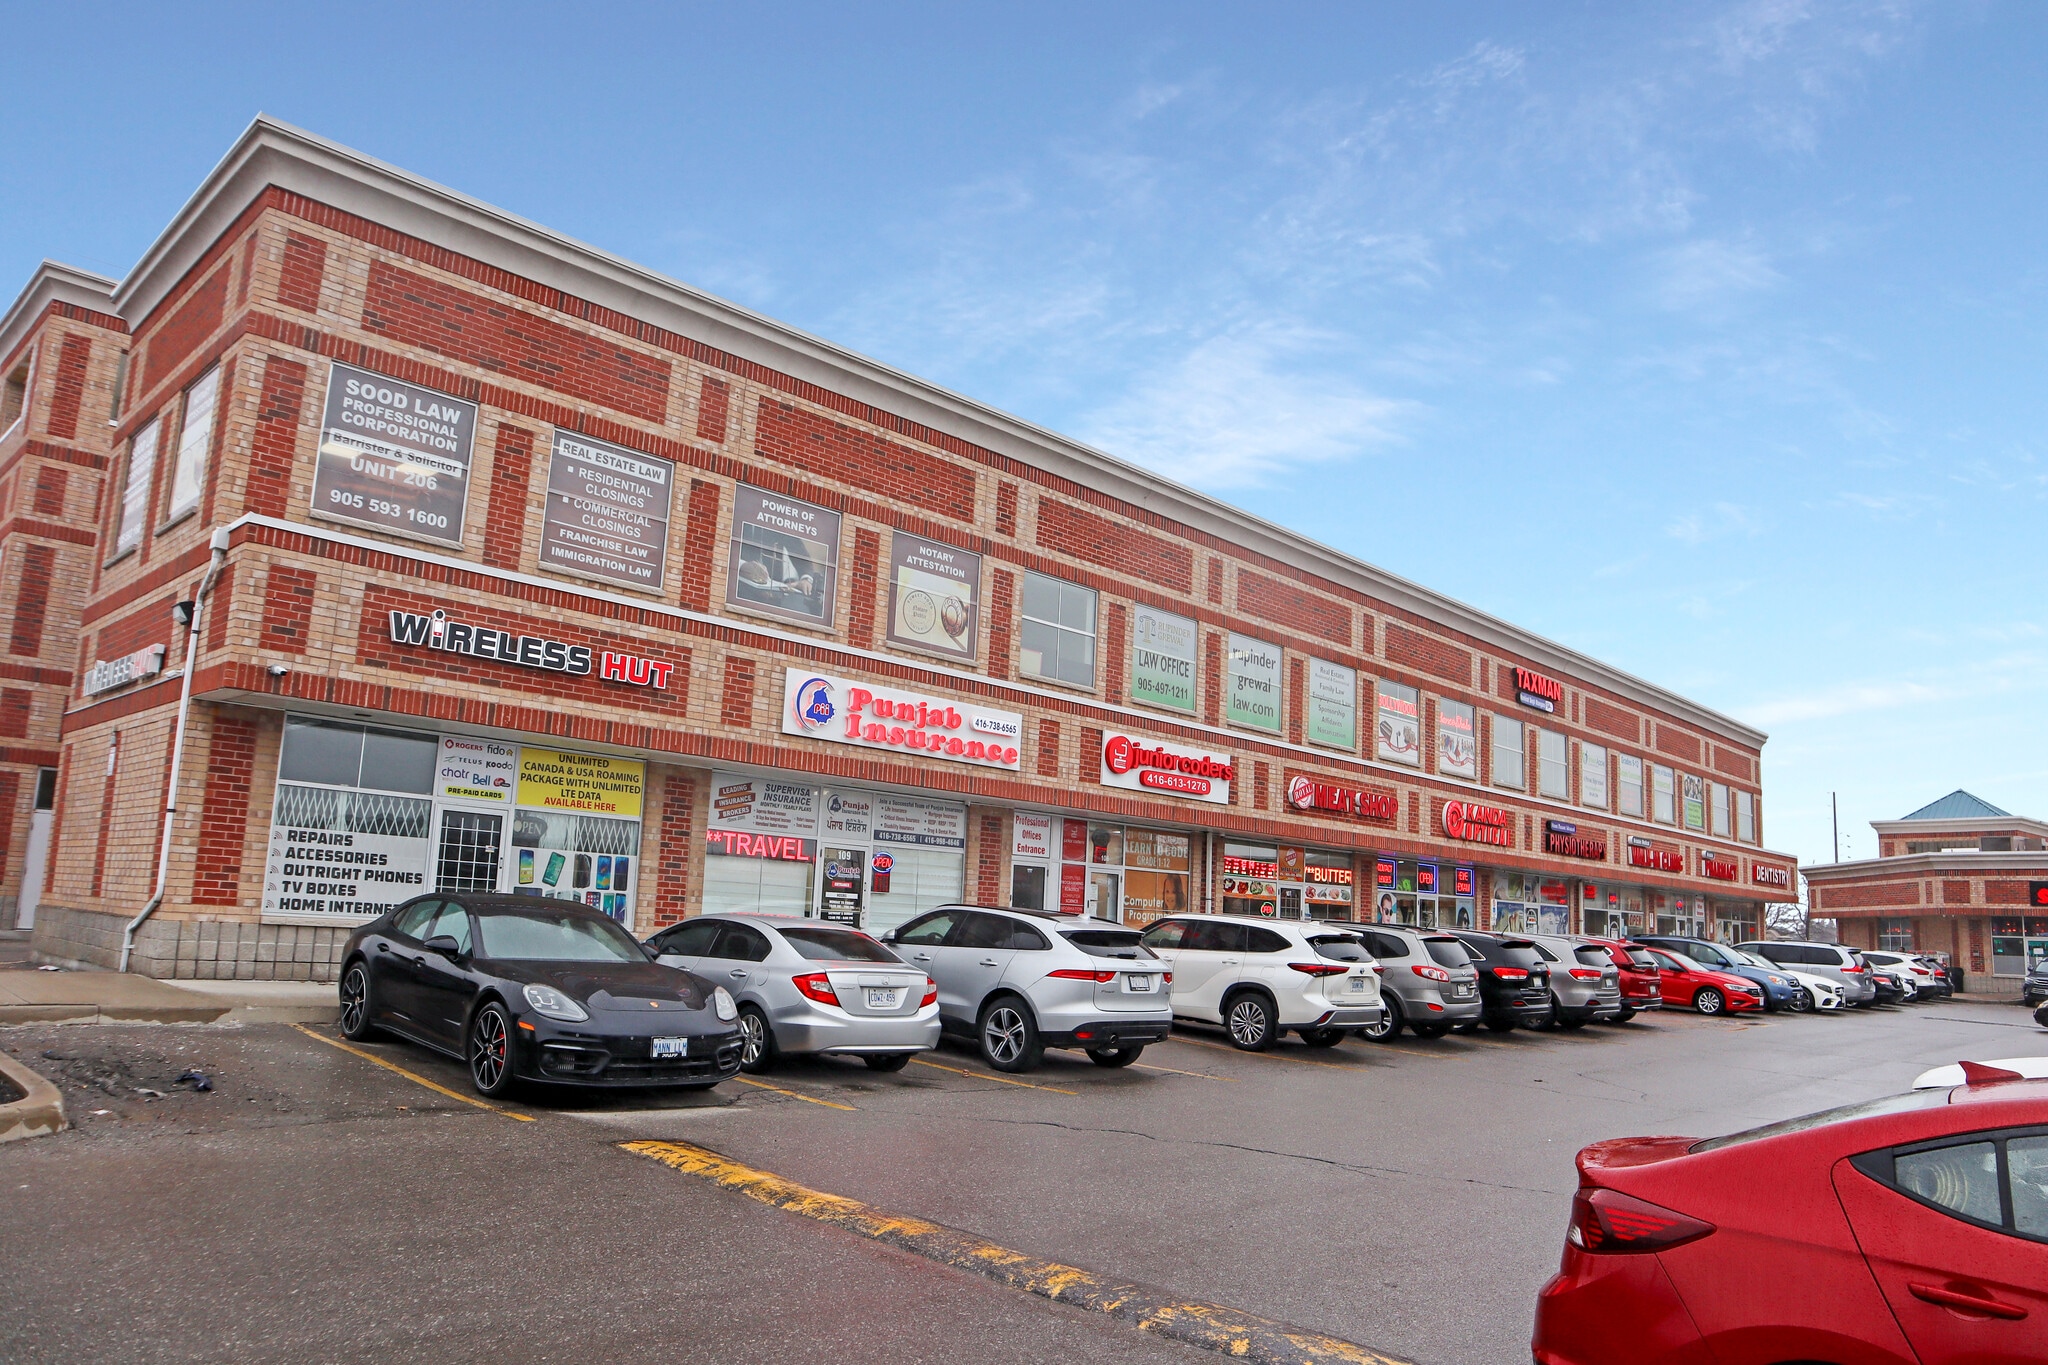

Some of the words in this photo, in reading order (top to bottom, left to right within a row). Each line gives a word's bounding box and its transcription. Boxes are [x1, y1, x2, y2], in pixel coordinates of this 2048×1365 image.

[346, 379, 407, 409] SOOD
[415, 399, 460, 425] LAW
[343, 397, 458, 438] PROFESSIONAL
[342, 411, 457, 453] CORPORATION
[333, 433, 390, 455] Barrister
[394, 449, 403, 458] &
[407, 452, 458, 473] Solicitor
[563, 443, 591, 460] REAL
[596, 453, 636, 472] ESTATE
[639, 466, 661, 479] LAW
[351, 456, 397, 480] UNIT
[404, 472, 438, 490] 206
[579, 468, 653, 498] RESIDENTIAL
[586, 484, 644, 508] CLOSINGS
[330, 489, 363, 508] 905
[369, 499, 400, 517] 593
[407, 508, 447, 528] 1600
[574, 498, 651, 528] COMMERCIAL
[762, 499, 798, 517] POWER
[801, 511, 814, 521] OF
[582, 514, 641, 538] CLOSINGS
[757, 512, 817, 536] ATTORNEYS
[560, 528, 622, 551] FRANCHISE
[625, 545, 648, 558] LAW
[551, 547, 626, 572] IMMIGRATION
[629, 565, 651, 578] LAW
[920, 546, 954, 562] NOTARY
[907, 555, 964, 578] ATTESTATION
[1158, 622, 1191, 638] RUPINDER
[1158, 632, 1184, 646] GREWAL
[1139, 650, 1158, 670] LAW
[1161, 656, 1189, 678] OFFICE
[1233, 648, 1276, 670] rupinder
[600, 651, 674, 689] HUT
[1320, 667, 1330, 675] Real
[1331, 670, 1344, 679] Estate
[1238, 675, 1271, 693] grewal
[1320, 683, 1334, 694] Family
[1517, 668, 1560, 701] TAXMAN
[847, 687, 963, 730] Punjab
[1233, 693, 1273, 717] law.com
[1319, 705, 1345, 718] Sponsorship
[975, 718, 1017, 735] 416-738-6565
[1322, 716, 1342, 727] Affidavits
[844, 713, 1018, 765] Insurance
[456, 742, 483, 751] ROGERS
[487, 744, 505, 755] fido
[559, 754, 609, 768] UNLIMITED
[442, 767, 469, 779] chatr
[473, 774, 490, 785] Bell
[524, 762, 564, 774] CANADA
[567, 767, 573, 775] &
[576, 768, 594, 777] USA
[597, 771, 639, 783] ROAMING
[521, 773, 564, 785] PACKAGE
[566, 778, 590, 788] WITH
[592, 782, 640, 794] UNLIMITED
[723, 785, 747, 794] LEADING
[765, 783, 810, 796] SUPERVISA
[1147, 773, 1207, 792] 416-613-1278
[1295, 785, 1312, 797] ROYAL
[448, 787, 479, 796] PRE-PAID
[561, 789, 575, 798] LTE
[578, 791, 601, 801] DATA
[764, 793, 811, 806] INSURANCE
[544, 797, 592, 809] AVAILABLE
[594, 802, 616, 811] HERE
[719, 795, 752, 806] INSURANCE
[842, 801, 869, 810] Punjab
[892, 800, 914, 808] Successful
[1314, 784, 1356, 812] MEAT
[1360, 792, 1399, 819] SHOP
[723, 807, 750, 817] BROKERS
[1468, 802, 1508, 827] KANDA
[513, 820, 541, 835] OPEN
[1016, 815, 1049, 828] Professional
[287, 830, 353, 846] REPAIRS
[1022, 830, 1042, 840] Offices
[1017, 843, 1045, 854] Entrance
[1126, 841, 1151, 854] LEARN
[1154, 844, 1163, 856] TO
[1166, 846, 1188, 858] CODE
[1550, 834, 1606, 859] PHYSIOTHERAPY
[285, 847, 387, 865] ACCESSORIES
[838, 851, 851, 860] 109
[874, 857, 893, 868] OPEN
[1137, 856, 1156, 866] GRADE
[284, 864, 361, 880] OUTRIGHT
[364, 870, 422, 884] PHONES
[1420, 872, 1433, 884] OPEN
[1458, 871, 1468, 881] EYE
[1756, 865, 1790, 884] DENTISTRY
[282, 881, 303, 893] TV
[306, 883, 357, 896] BOXES
[279, 898, 325, 912] HOME
[1124, 895, 1164, 909] Computer
